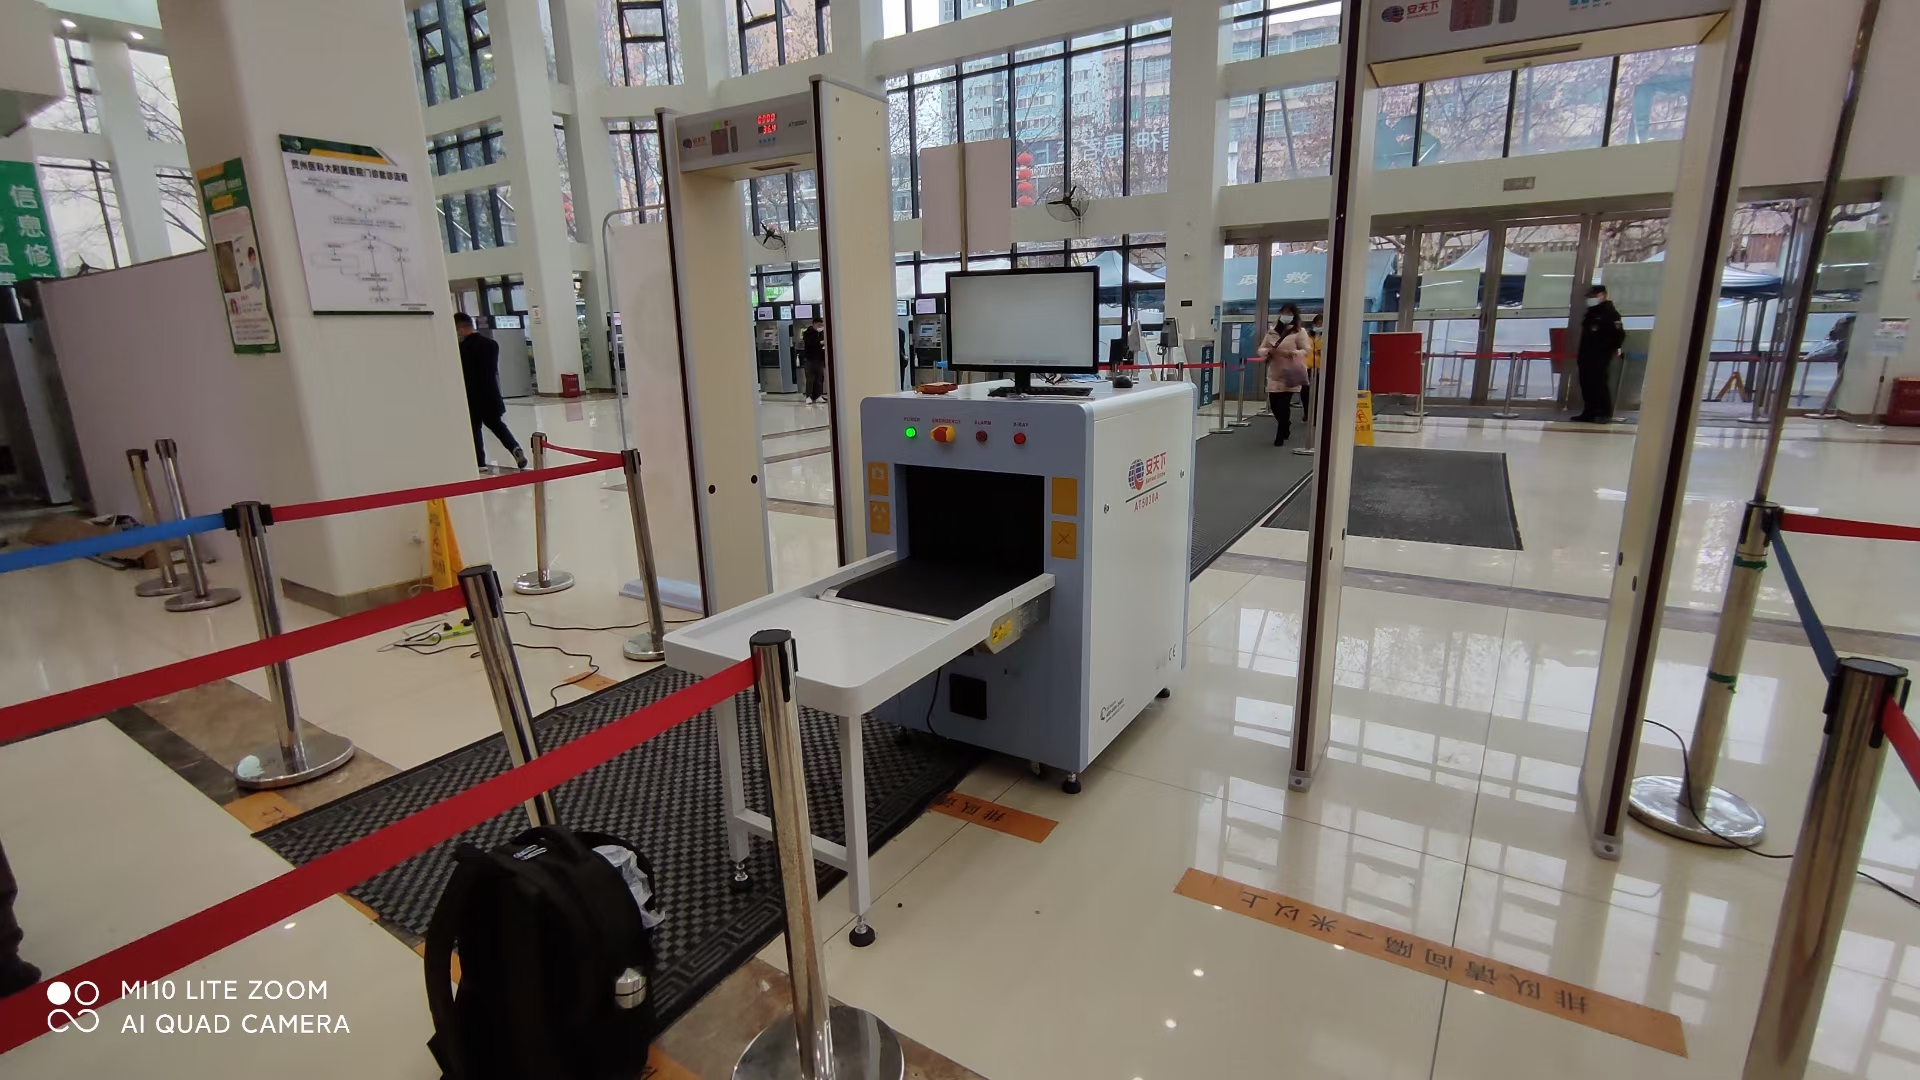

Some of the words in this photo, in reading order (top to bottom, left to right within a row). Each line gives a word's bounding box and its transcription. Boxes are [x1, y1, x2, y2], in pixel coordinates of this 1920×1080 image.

[1407, 0, 1439, 15] 安天下
[757, 112, 777, 125] 0000
[9, 184, 57, 279] 信息修
[1146, 451, 1167, 476] 安天下
[1240, 889, 1590, 1015] 排队请间隔一米以上
